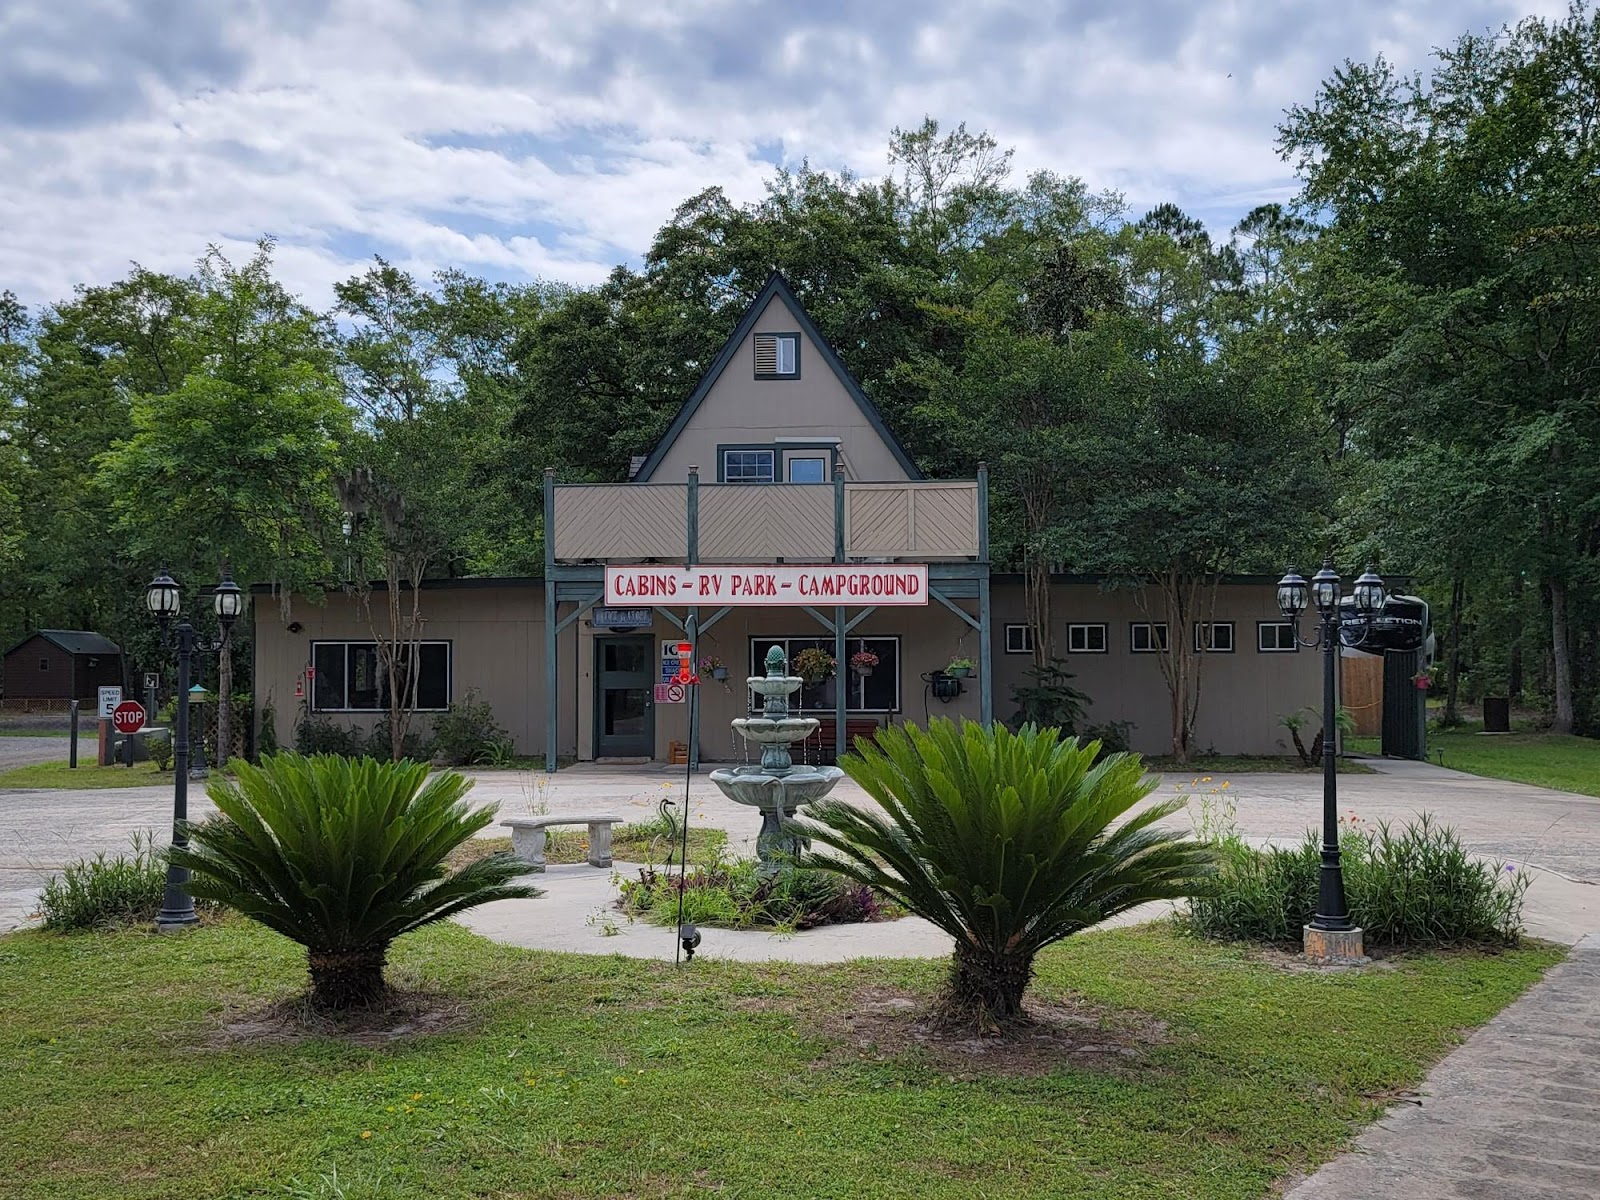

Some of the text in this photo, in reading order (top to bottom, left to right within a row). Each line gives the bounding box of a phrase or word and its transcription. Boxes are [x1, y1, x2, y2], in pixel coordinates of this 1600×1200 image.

[614, 574, 676, 596] CABINS
[699, 574, 722, 596] RV
[731, 574, 777, 596] PARK
[798, 574, 919, 596] CAMPGROUND
[106, 703, 114, 715] 5
[115, 711, 143, 724] STOP
